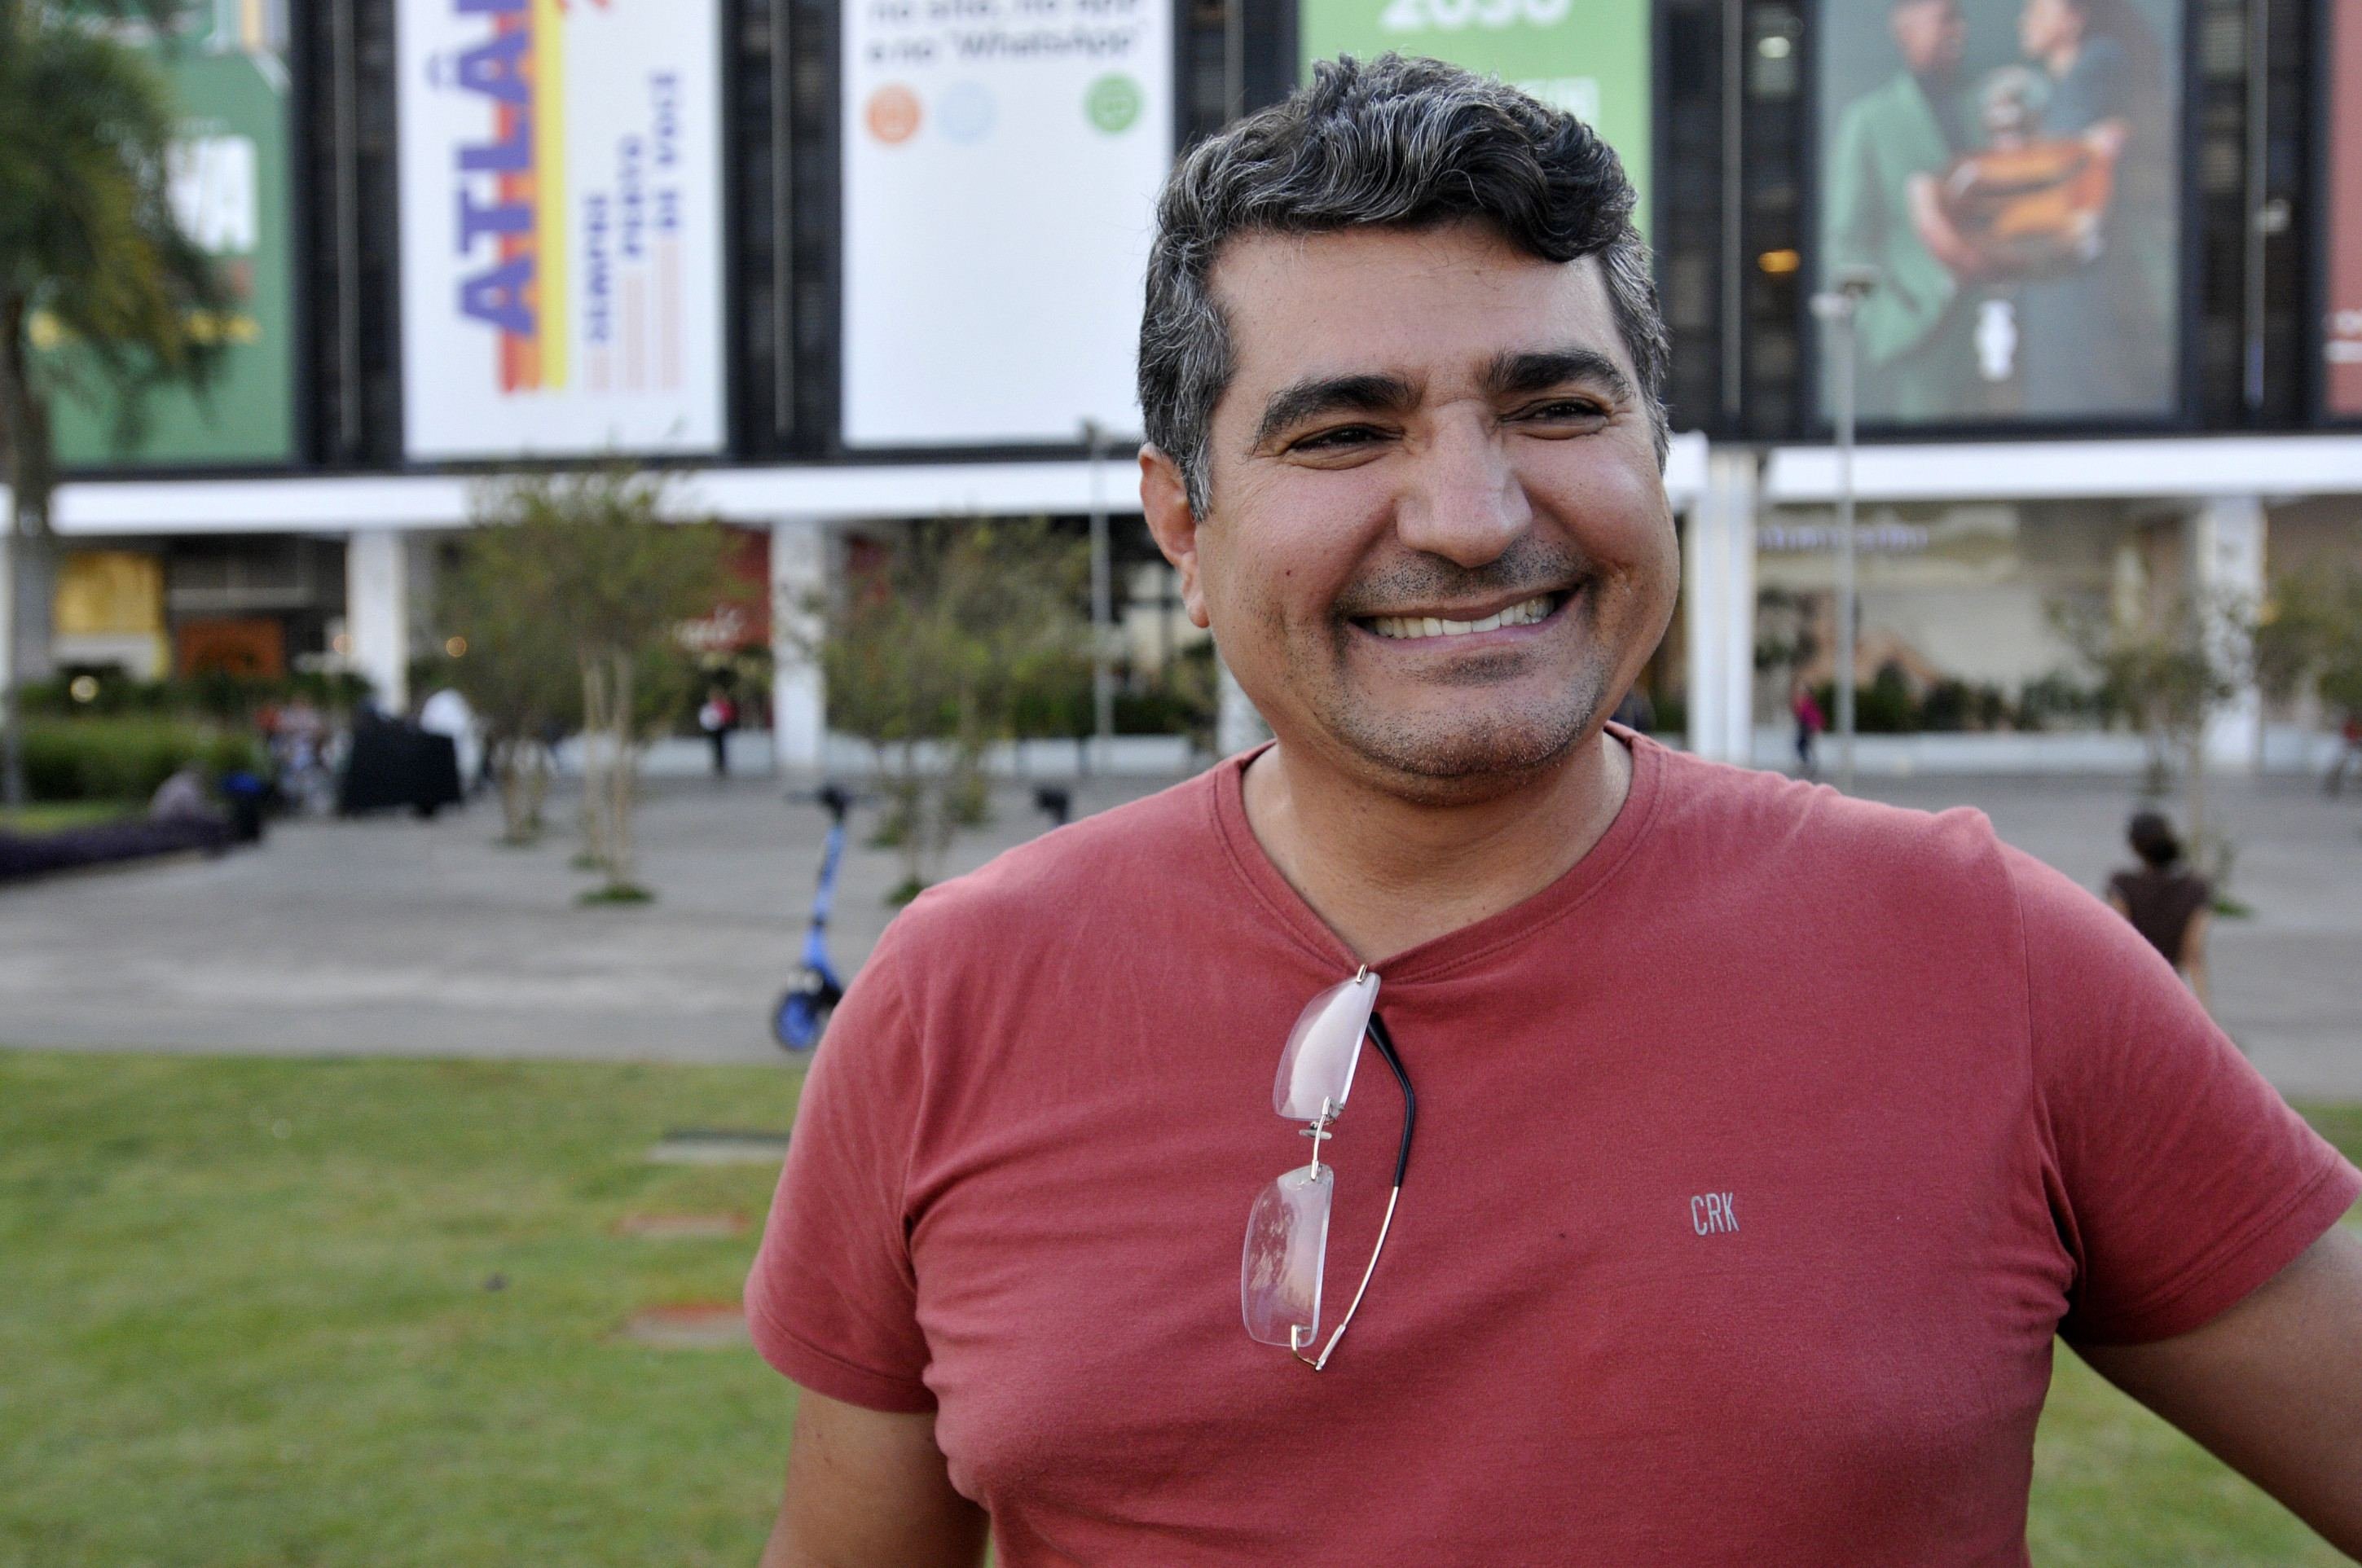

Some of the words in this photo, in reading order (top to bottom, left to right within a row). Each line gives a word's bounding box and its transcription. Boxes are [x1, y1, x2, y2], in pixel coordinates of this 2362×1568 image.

[424, 0, 534, 339] ATLÂ
[619, 134, 643, 259] PERTO
[652, 187, 678, 231] DE
[586, 191, 609, 343] SEMPRE
[1691, 1192, 1740, 1236] CRK
